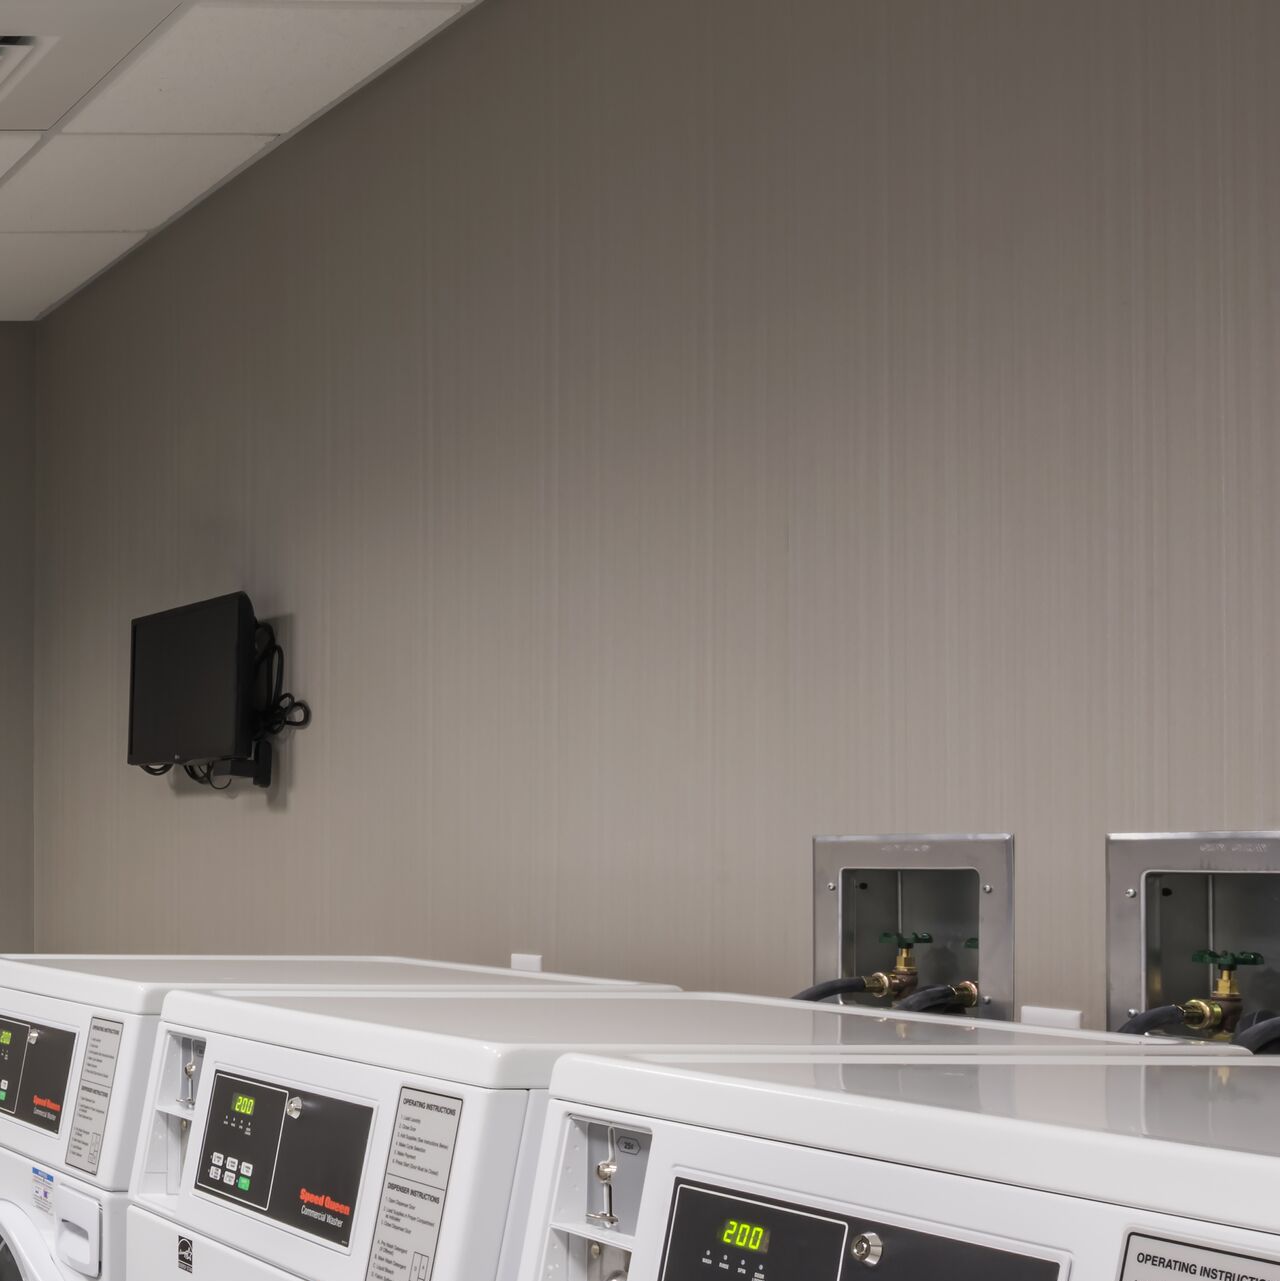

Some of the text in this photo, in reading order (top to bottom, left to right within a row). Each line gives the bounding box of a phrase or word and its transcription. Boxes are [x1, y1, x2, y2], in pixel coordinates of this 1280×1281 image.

[235, 1096, 254, 1114] 200
[300, 1187, 350, 1215] Speed Queen
[301, 1204, 343, 1228] Commercial Washer
[722, 1221, 763, 1250] 200
[1137, 1252, 1197, 1275] OPERATING
